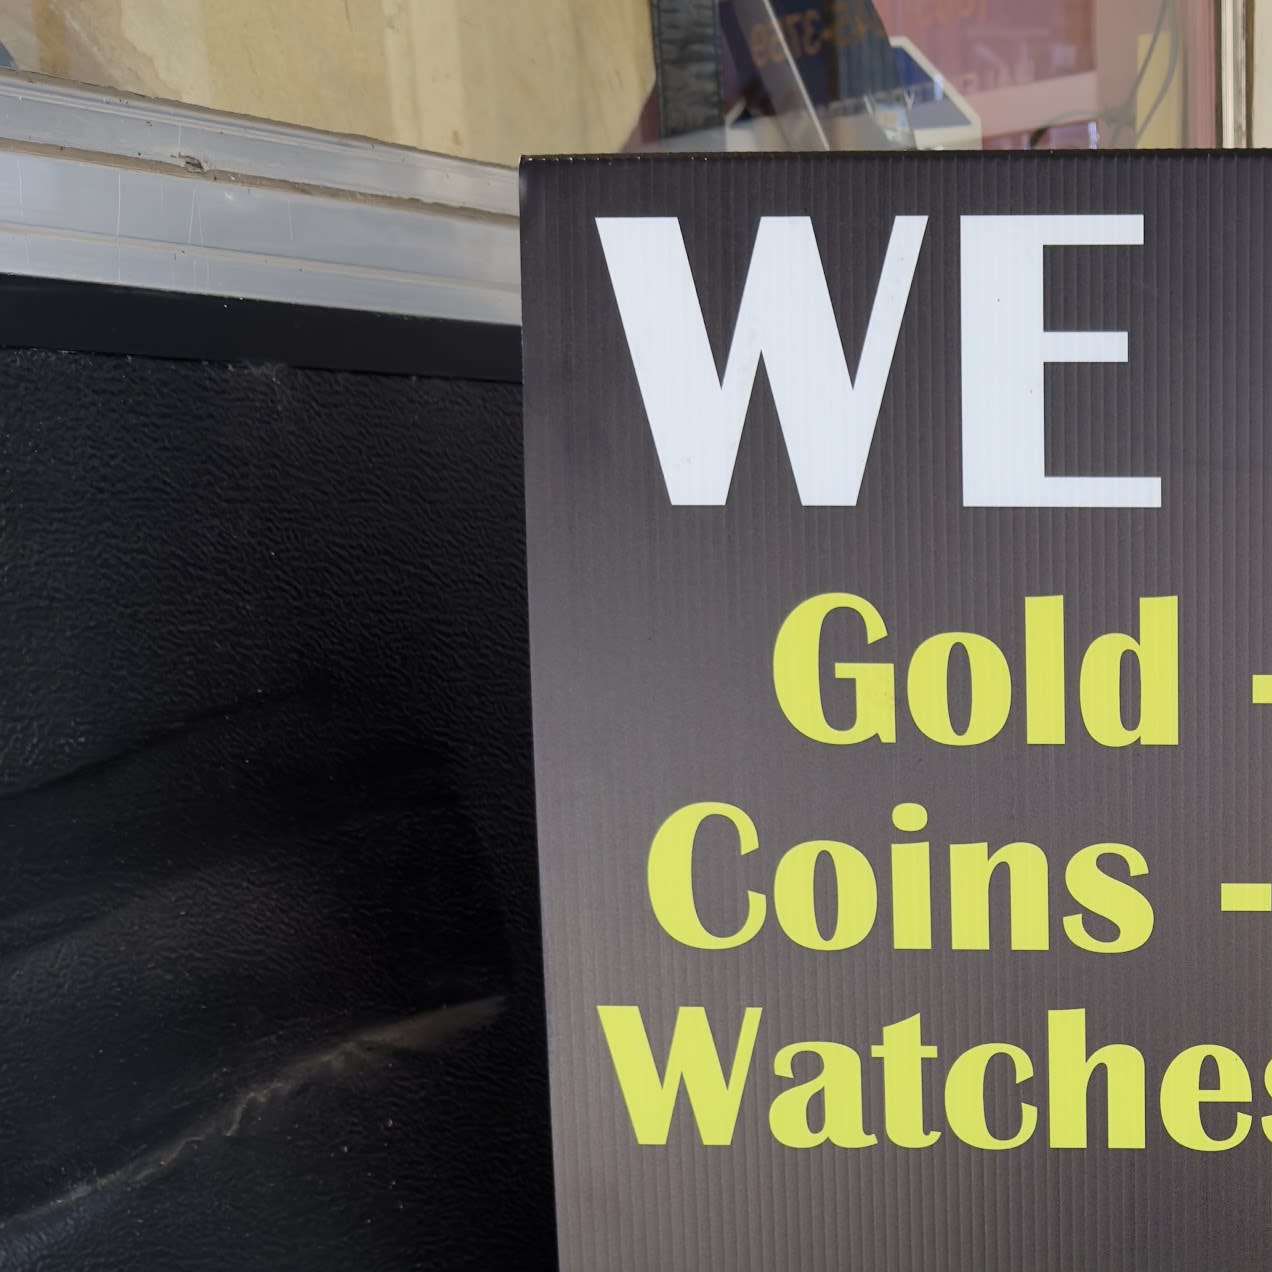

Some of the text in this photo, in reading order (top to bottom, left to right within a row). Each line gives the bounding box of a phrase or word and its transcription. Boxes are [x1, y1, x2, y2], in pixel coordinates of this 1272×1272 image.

[595, 214, 1162, 508] WE
[772, 593, 1178, 748] Gold
[646, 802, 1153, 954] Coins
[1220, 884, 1271, 912] -
